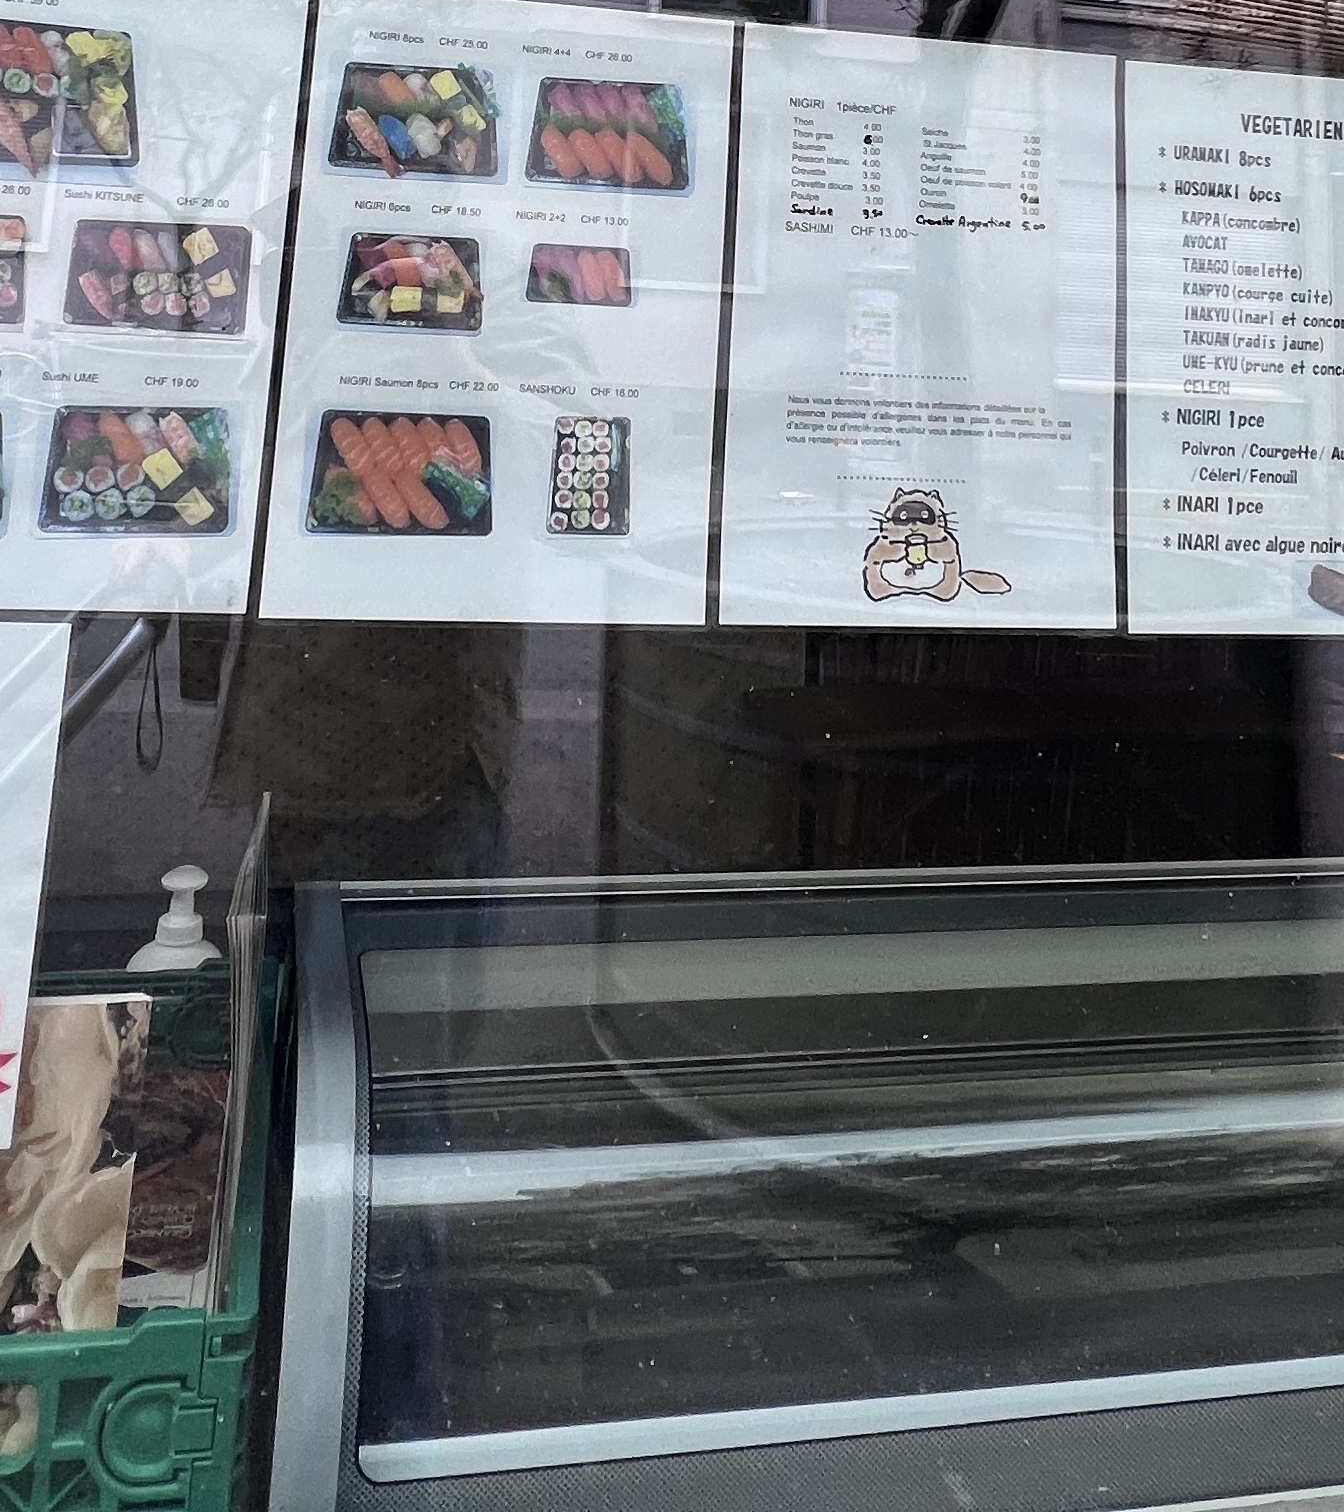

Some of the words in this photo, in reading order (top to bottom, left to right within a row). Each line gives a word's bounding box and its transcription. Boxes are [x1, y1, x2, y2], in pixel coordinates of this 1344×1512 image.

[369, 30, 400, 42] NIGIRI
[439, 37, 460, 48] CHF
[522, 44, 552, 56] NIGIRI
[585, 50, 605, 60] CHF
[789, 97, 825, 110] NIGIRI
[1241, 113, 1344, 141] VEGETARIEN
[1174, 145, 1230, 165] URAMAKI
[1239, 151, 1272, 168] 8pcs
[64, 188, 92, 201] Sushi
[95, 190, 144, 204] KITSUNE
[176, 195, 199, 207] CHF
[1174, 180, 1240, 200] HOSOMAKI
[1249, 185, 1282, 203] 6pcs
[355, 200, 386, 212] NIGIRI
[431, 205, 452, 216] CHF
[516, 210, 547, 222] NIGIRI
[581, 215, 601, 225] CHF
[785, 221, 834, 235] SASHIMI
[851, 225, 876, 237] CHF
[1182, 234, 1228, 251] AVOCAT
[1291, 289, 1333, 307] cuite)
[1282, 312, 1296, 327] et
[1282, 335, 1324, 353] jaune)
[1291, 360, 1305, 375] et
[42, 370, 72, 382] Sushi
[73, 372, 100, 384] UME
[145, 376, 167, 387] CHF
[339, 375, 372, 387] NIGIRI
[375, 377, 413, 389] Saumon
[449, 380, 470, 391] CHF
[519, 383, 576, 396] SANSHOKU
[591, 387, 611, 397] CHF
[1183, 379, 1231, 396] CELERI
[1177, 408, 1221, 426] NIGIRI
[1229, 410, 1265, 429] 1pce
[1181, 441, 1235, 457] Poivron
[1177, 495, 1219, 512] INARI
[1228, 497, 1263, 516] 1pce
[1177, 533, 1220, 552] INARI
[1225, 538, 1261, 552] avec
[1266, 536, 1305, 555] algue
